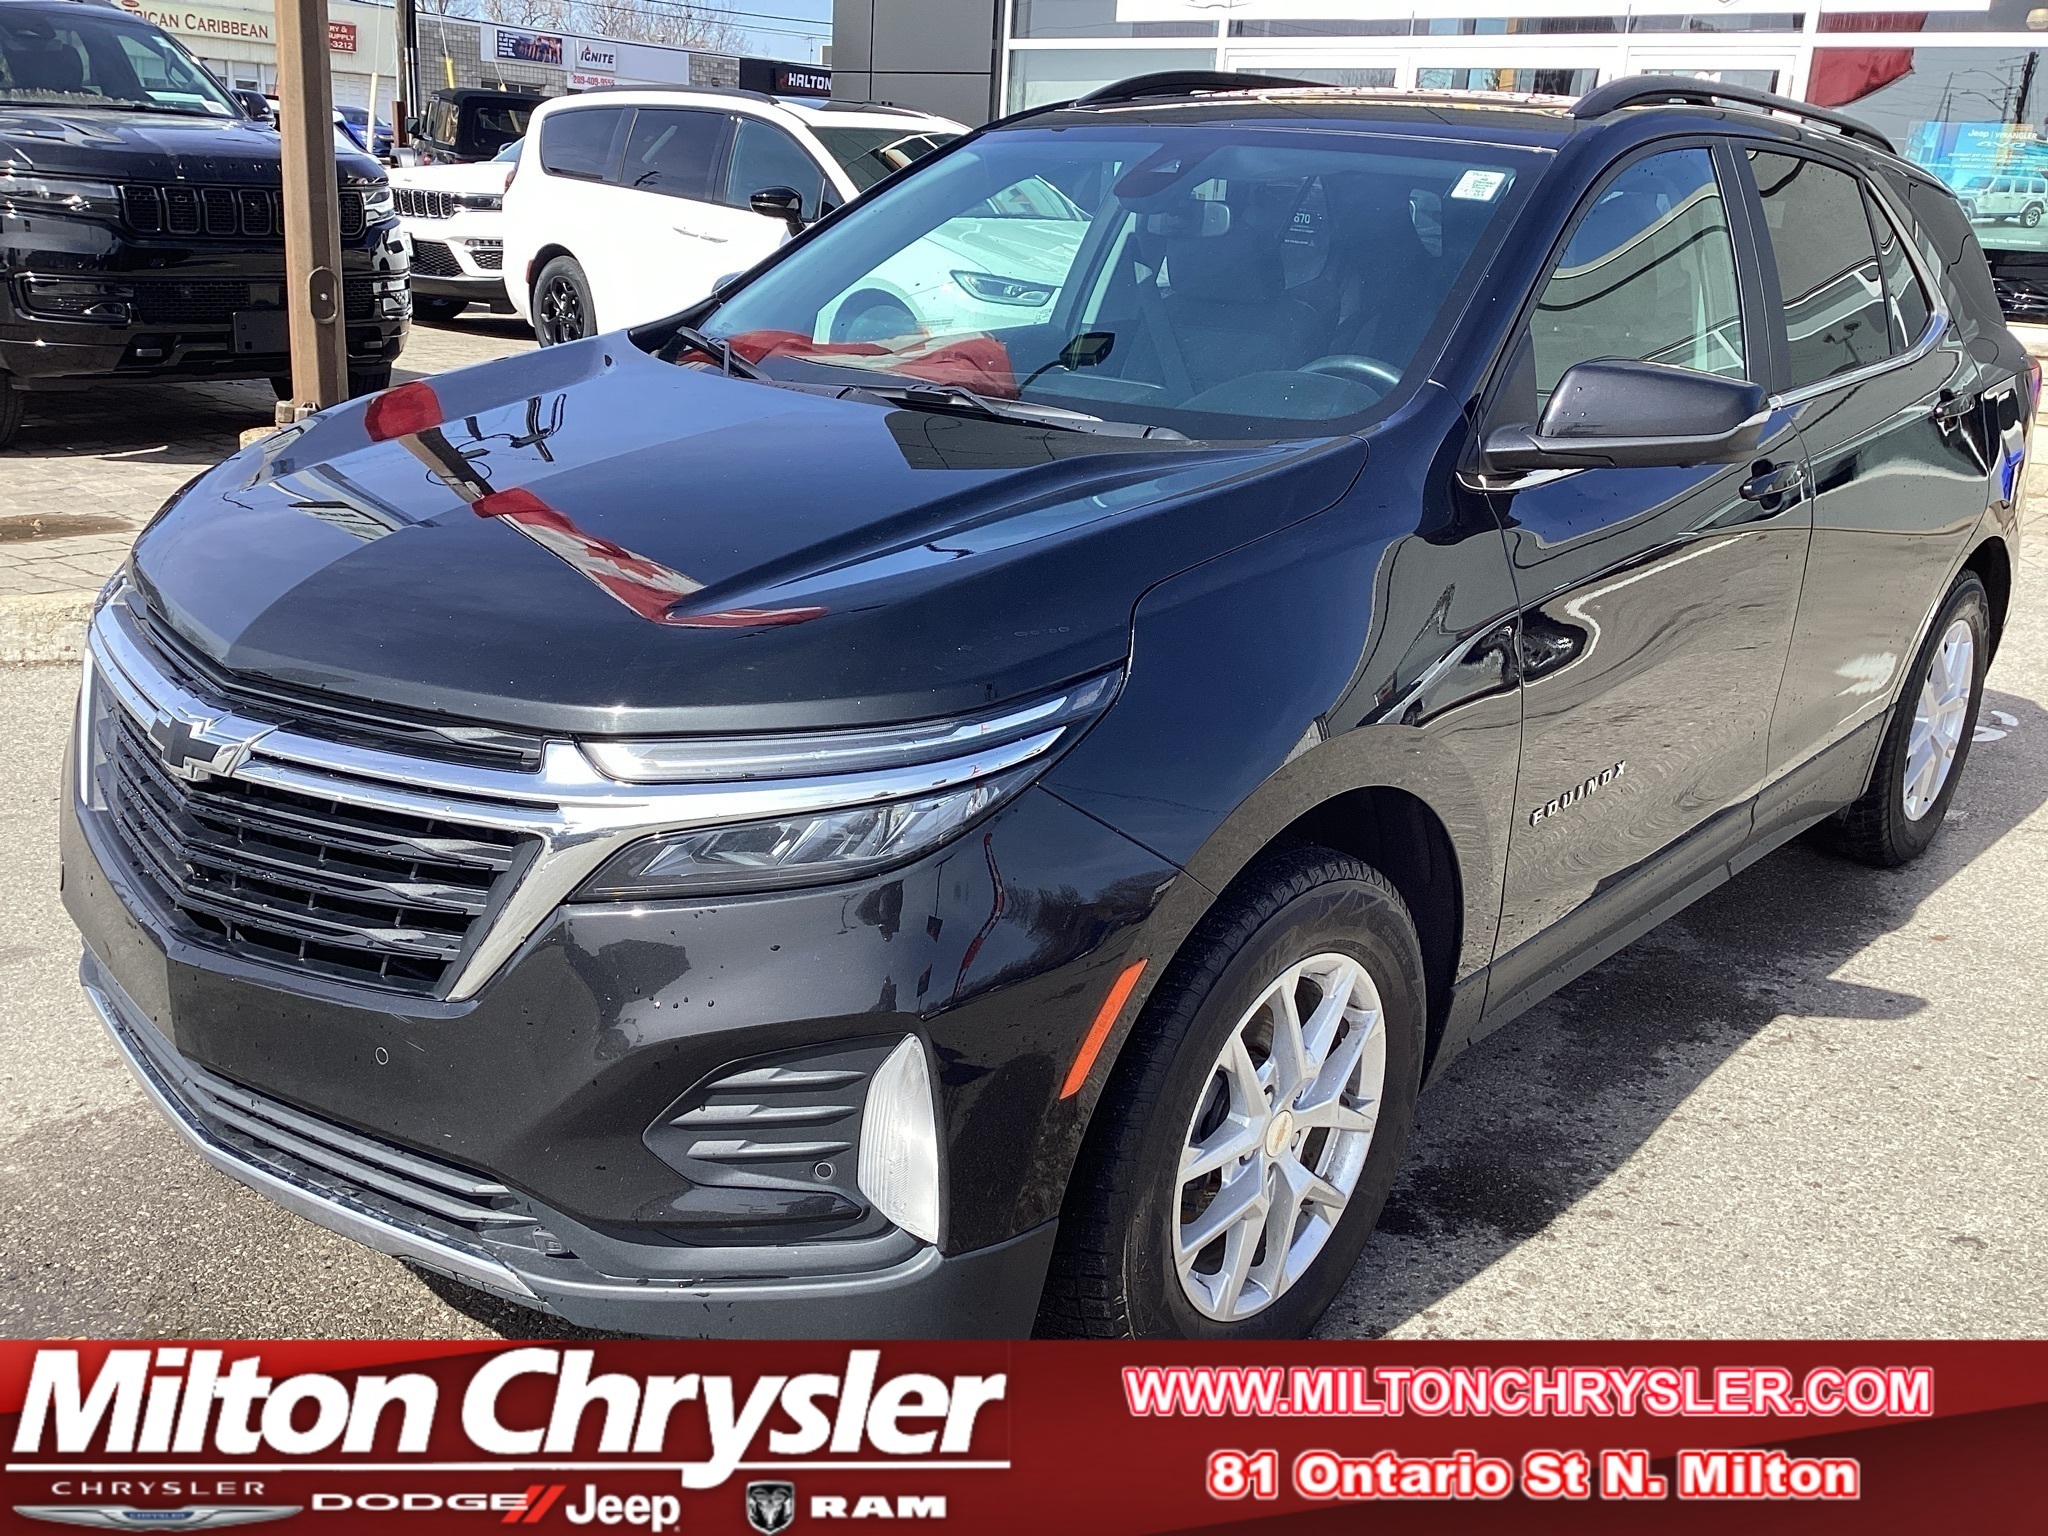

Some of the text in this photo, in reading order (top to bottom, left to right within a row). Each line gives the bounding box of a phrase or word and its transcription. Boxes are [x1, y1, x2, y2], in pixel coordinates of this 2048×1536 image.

[184, 13, 269, 39] CARIBBEAN
[580, 50, 615, 64] IGNITE
[788, 72, 832, 91] HALTON
[1968, 129, 2038, 140] Jeep WRANGLER
[1529, 760, 1626, 827] EQUINOX
